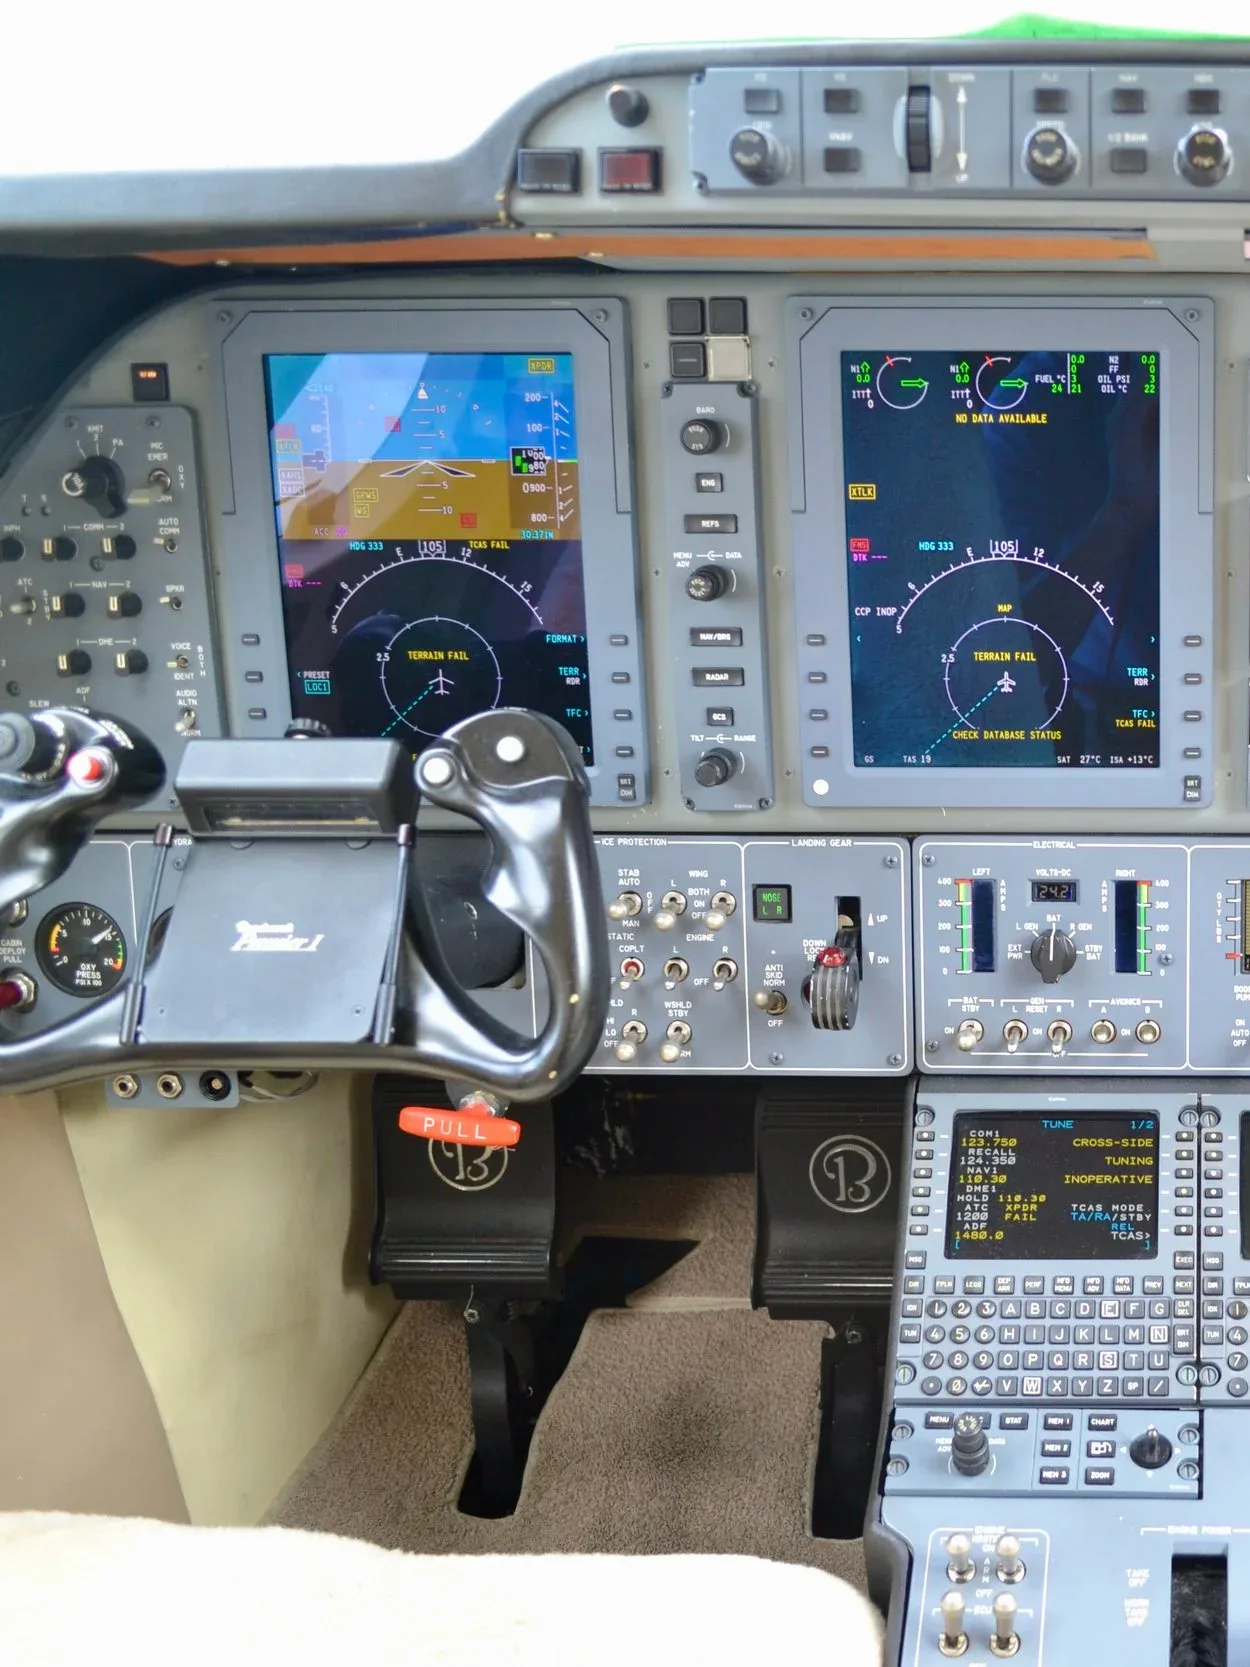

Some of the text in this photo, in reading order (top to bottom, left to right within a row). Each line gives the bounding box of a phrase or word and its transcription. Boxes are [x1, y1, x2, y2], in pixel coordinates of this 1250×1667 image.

[1035, 374, 1054, 383] FUEL
[1097, 375, 1131, 384] OIL PSI
[1101, 384, 1116, 393] OIL
[696, 406, 715, 414] BARO
[955, 414, 1047, 423] NO DATA AVAILABLE
[148, 453, 168, 461] EMER
[701, 479, 716, 487] ENG
[158, 518, 179, 526] AUTO
[701, 520, 720, 528] REFS
[159, 527, 180, 536] COMM
[350, 541, 384, 551] HDG 333
[468, 540, 510, 549] TCAS FAIL
[919, 541, 954, 551] HDG 333
[855, 607, 897, 617] CCP INOP
[997, 604, 1012, 613] MAP
[546, 634, 577, 644] FORMAT
[171, 642, 192, 651] VOICE
[407, 651, 470, 660] TERRAIN FAIL
[973, 652, 1036, 661] TERRAIN FAIL
[303, 670, 330, 680] PRESET
[558, 667, 580, 676] TERR
[1127, 668, 1148, 677] TERR
[173, 672, 195, 682] IDENT
[705, 673, 729, 681] RADAR
[175, 690, 198, 698] AUDIO
[177, 698, 198, 707] ALTN
[566, 708, 582, 717] TFC
[1132, 709, 1148, 718] TFC
[1115, 719, 1156, 728] TCAS FAIL
[690, 734, 757, 742] TILT RANGE
[952, 730, 1062, 740] CHECK DATABASE STATUS
[601, 838, 667, 846] ICE PROTECTION
[791, 839, 852, 847] LANDING GEAR
[1032, 841, 1076, 849] ELECTRICAL
[618, 868, 640, 877] STAB
[688, 870, 709, 878] WING
[972, 868, 991, 876] LEFT
[1035, 868, 1072, 877] VOLTS-DC
[1115, 869, 1136, 878] RIGHT
[618, 877, 641, 886] AUTO
[687, 888, 710, 896] BOTH
[762, 893, 782, 902] NOSE
[1046, 914, 1062, 922] BAT
[686, 933, 715, 942] ENGINE
[619, 945, 645, 953] COPLT
[3, 955, 23, 964] PULL
[80, 963, 97, 971] OXY
[764, 964, 784, 972] ANTI
[76, 970, 101, 979] PRESS
[765, 971, 783, 979] SKID
[763, 979, 786, 987] NORM
[664, 1001, 692, 1009] WSHLD
[1110, 998, 1141, 1006] AVIONICS
[667, 1009, 689, 1018] STBY
[767, 1019, 783, 1028] OFF
[423, 1117, 487, 1140] PULL
[1042, 1120, 1074, 1129] TUNE
[1130, 1120, 1155, 1130] 1/2
[969, 1130, 1000, 1138] COM1
[961, 1138, 1018, 1148] 123.750
[1072, 1138, 1154, 1148] CROSS-SIDE
[968, 1148, 1016, 1156] RECALL
[959, 1156, 1016, 1166] 124.350
[1104, 1156, 1154, 1166] TUNING
[966, 1166, 998, 1175] NAV1
[959, 1174, 1008, 1184] 110.30
[1064, 1175, 1153, 1185] INOPERATIVE
[965, 1185, 997, 1193] DME1
[957, 1194, 1047, 1203] HOLD 110.30
[964, 1204, 989, 1212] ATC
[1005, 1204, 1038, 1212] XPDR
[1071, 1204, 1144, 1212] TCAS MODE
[956, 1212, 989, 1221] 1200
[1004, 1212, 1036, 1221] FAIL
[1070, 1212, 1152, 1222] TA/RA/STBY
[963, 1222, 988, 1231] ADF
[1111, 1222, 1135, 1231] REL
[954, 1230, 1004, 1241] 1480.0
[908, 1256, 923, 1264] MSG
[1175, 1256, 1193, 1264] EXEC
[965, 1280, 982, 1288] LEGS
[1025, 1280, 1042, 1288] PERF
[1176, 1280, 1193, 1288] NEXT
[929, 1416, 950, 1424] MENU
[1005, 1417, 1022, 1425] STAT
[1091, 1418, 1115, 1426] CHART
[1090, 1471, 1110, 1479] ZOOM
